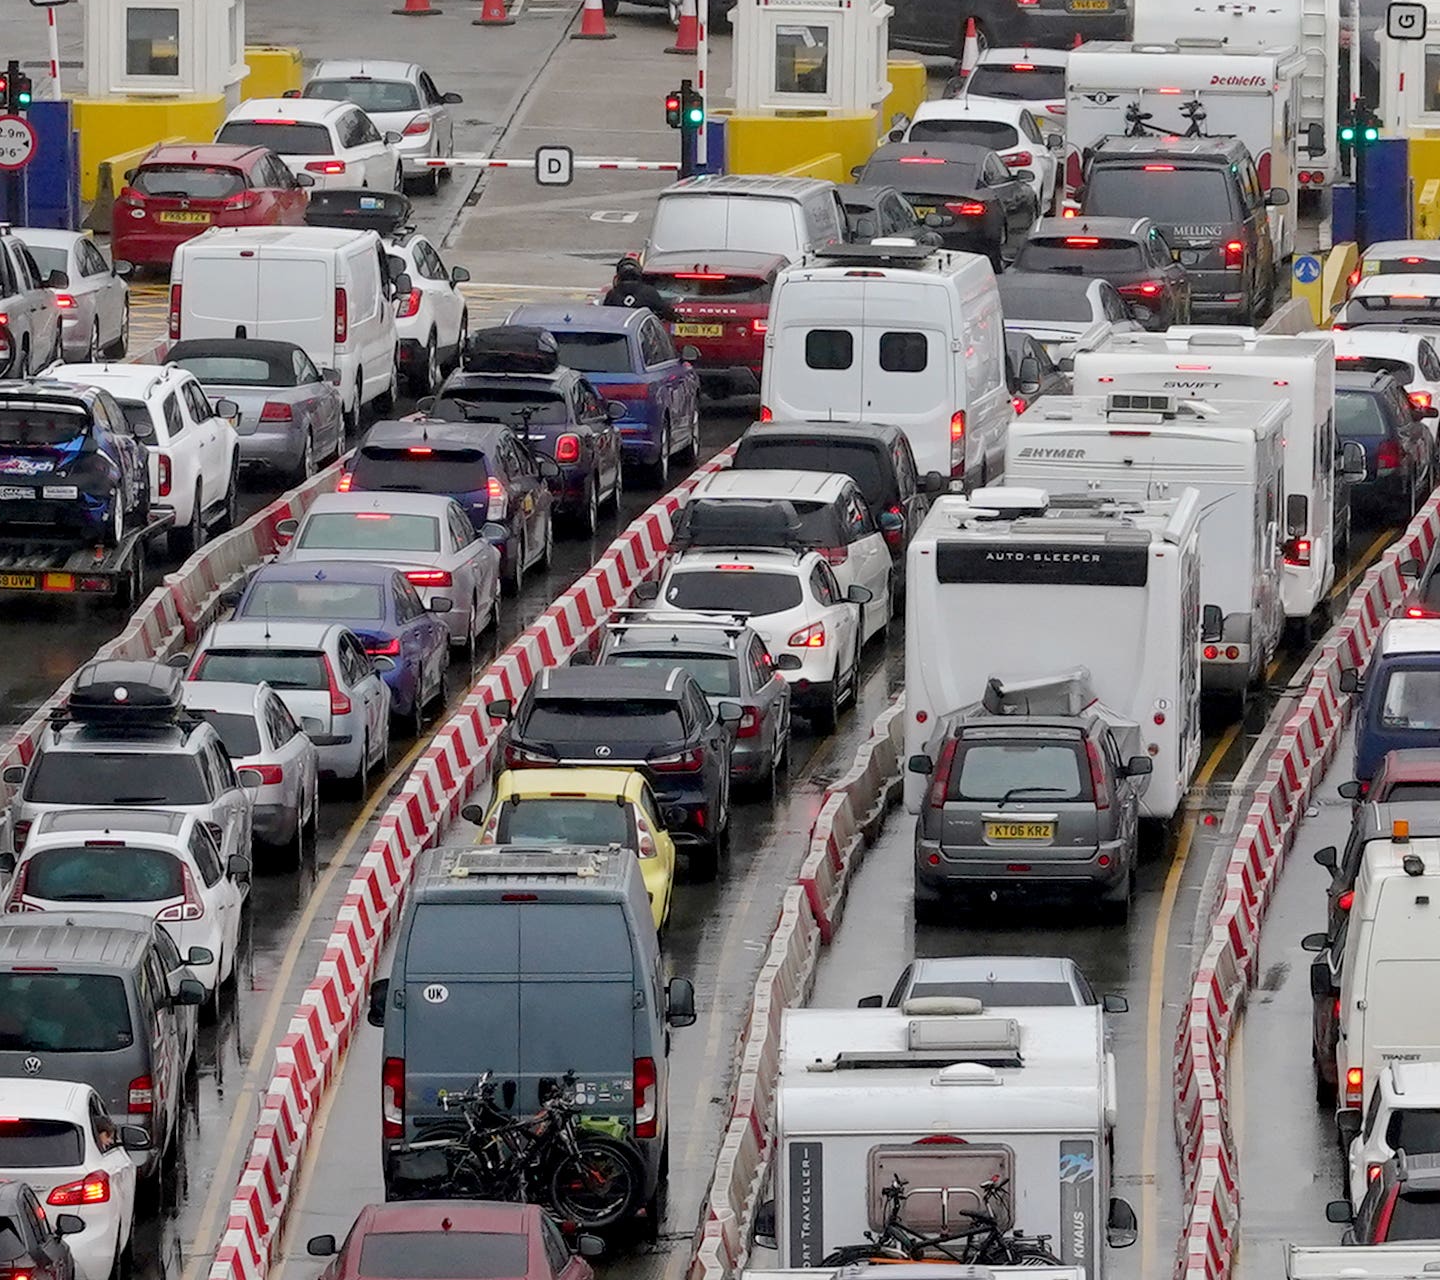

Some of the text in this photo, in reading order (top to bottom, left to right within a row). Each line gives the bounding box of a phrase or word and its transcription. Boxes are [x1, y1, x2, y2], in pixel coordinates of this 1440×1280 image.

[1398, 14, 1415, 28] G
[1209, 74, 1267, 87] Dethleffs
[548, 159, 561, 173] D
[1173, 227, 1222, 236] MELLING
[1033, 448, 1086, 459] HYMER
[994, 825, 1050, 837] KT06 KRZ
[428, 988, 443, 1000] UK
[1073, 1210, 1084, 1259] KNAUS
